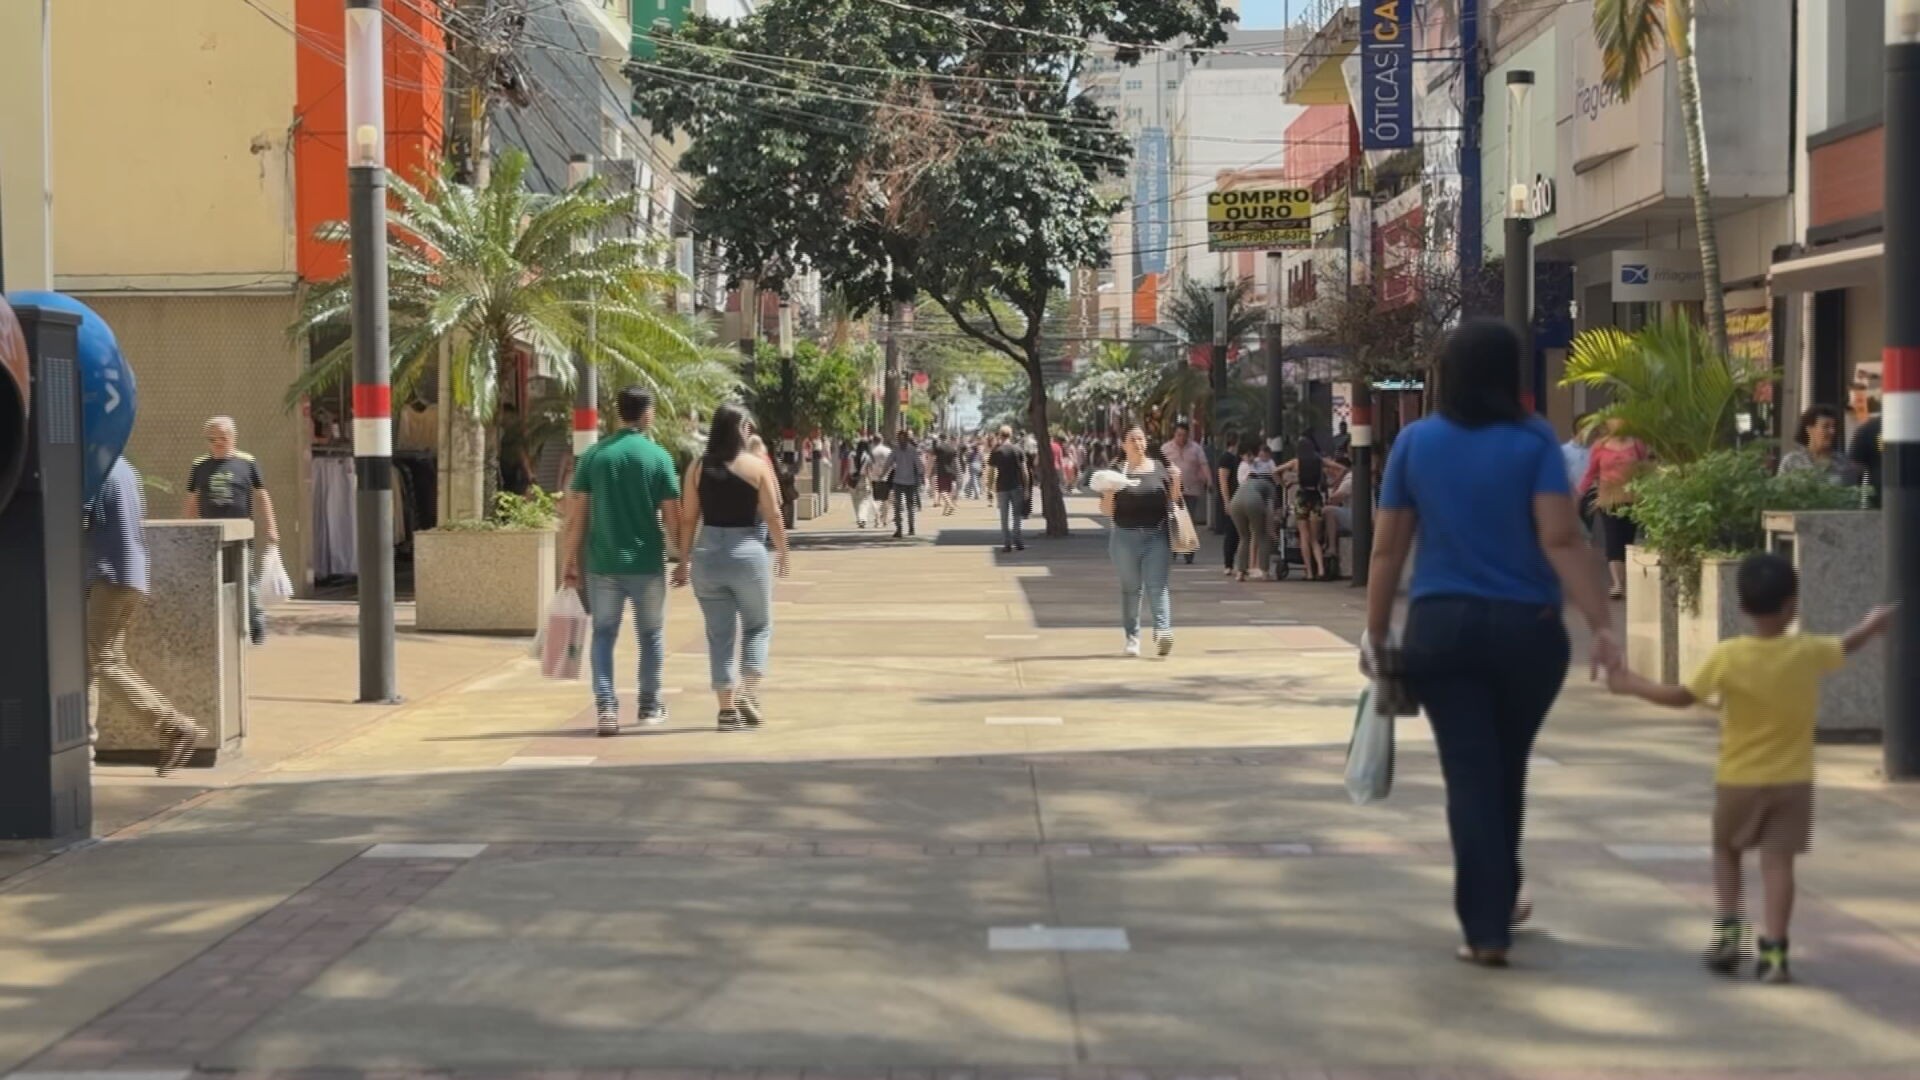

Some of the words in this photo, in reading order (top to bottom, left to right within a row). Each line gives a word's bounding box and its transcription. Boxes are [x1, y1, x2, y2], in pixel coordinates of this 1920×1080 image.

[1368, 53, 1399, 141] ÓTICAS
[1208, 189, 1309, 206] COMPRO
[1226, 205, 1292, 220] OURO
